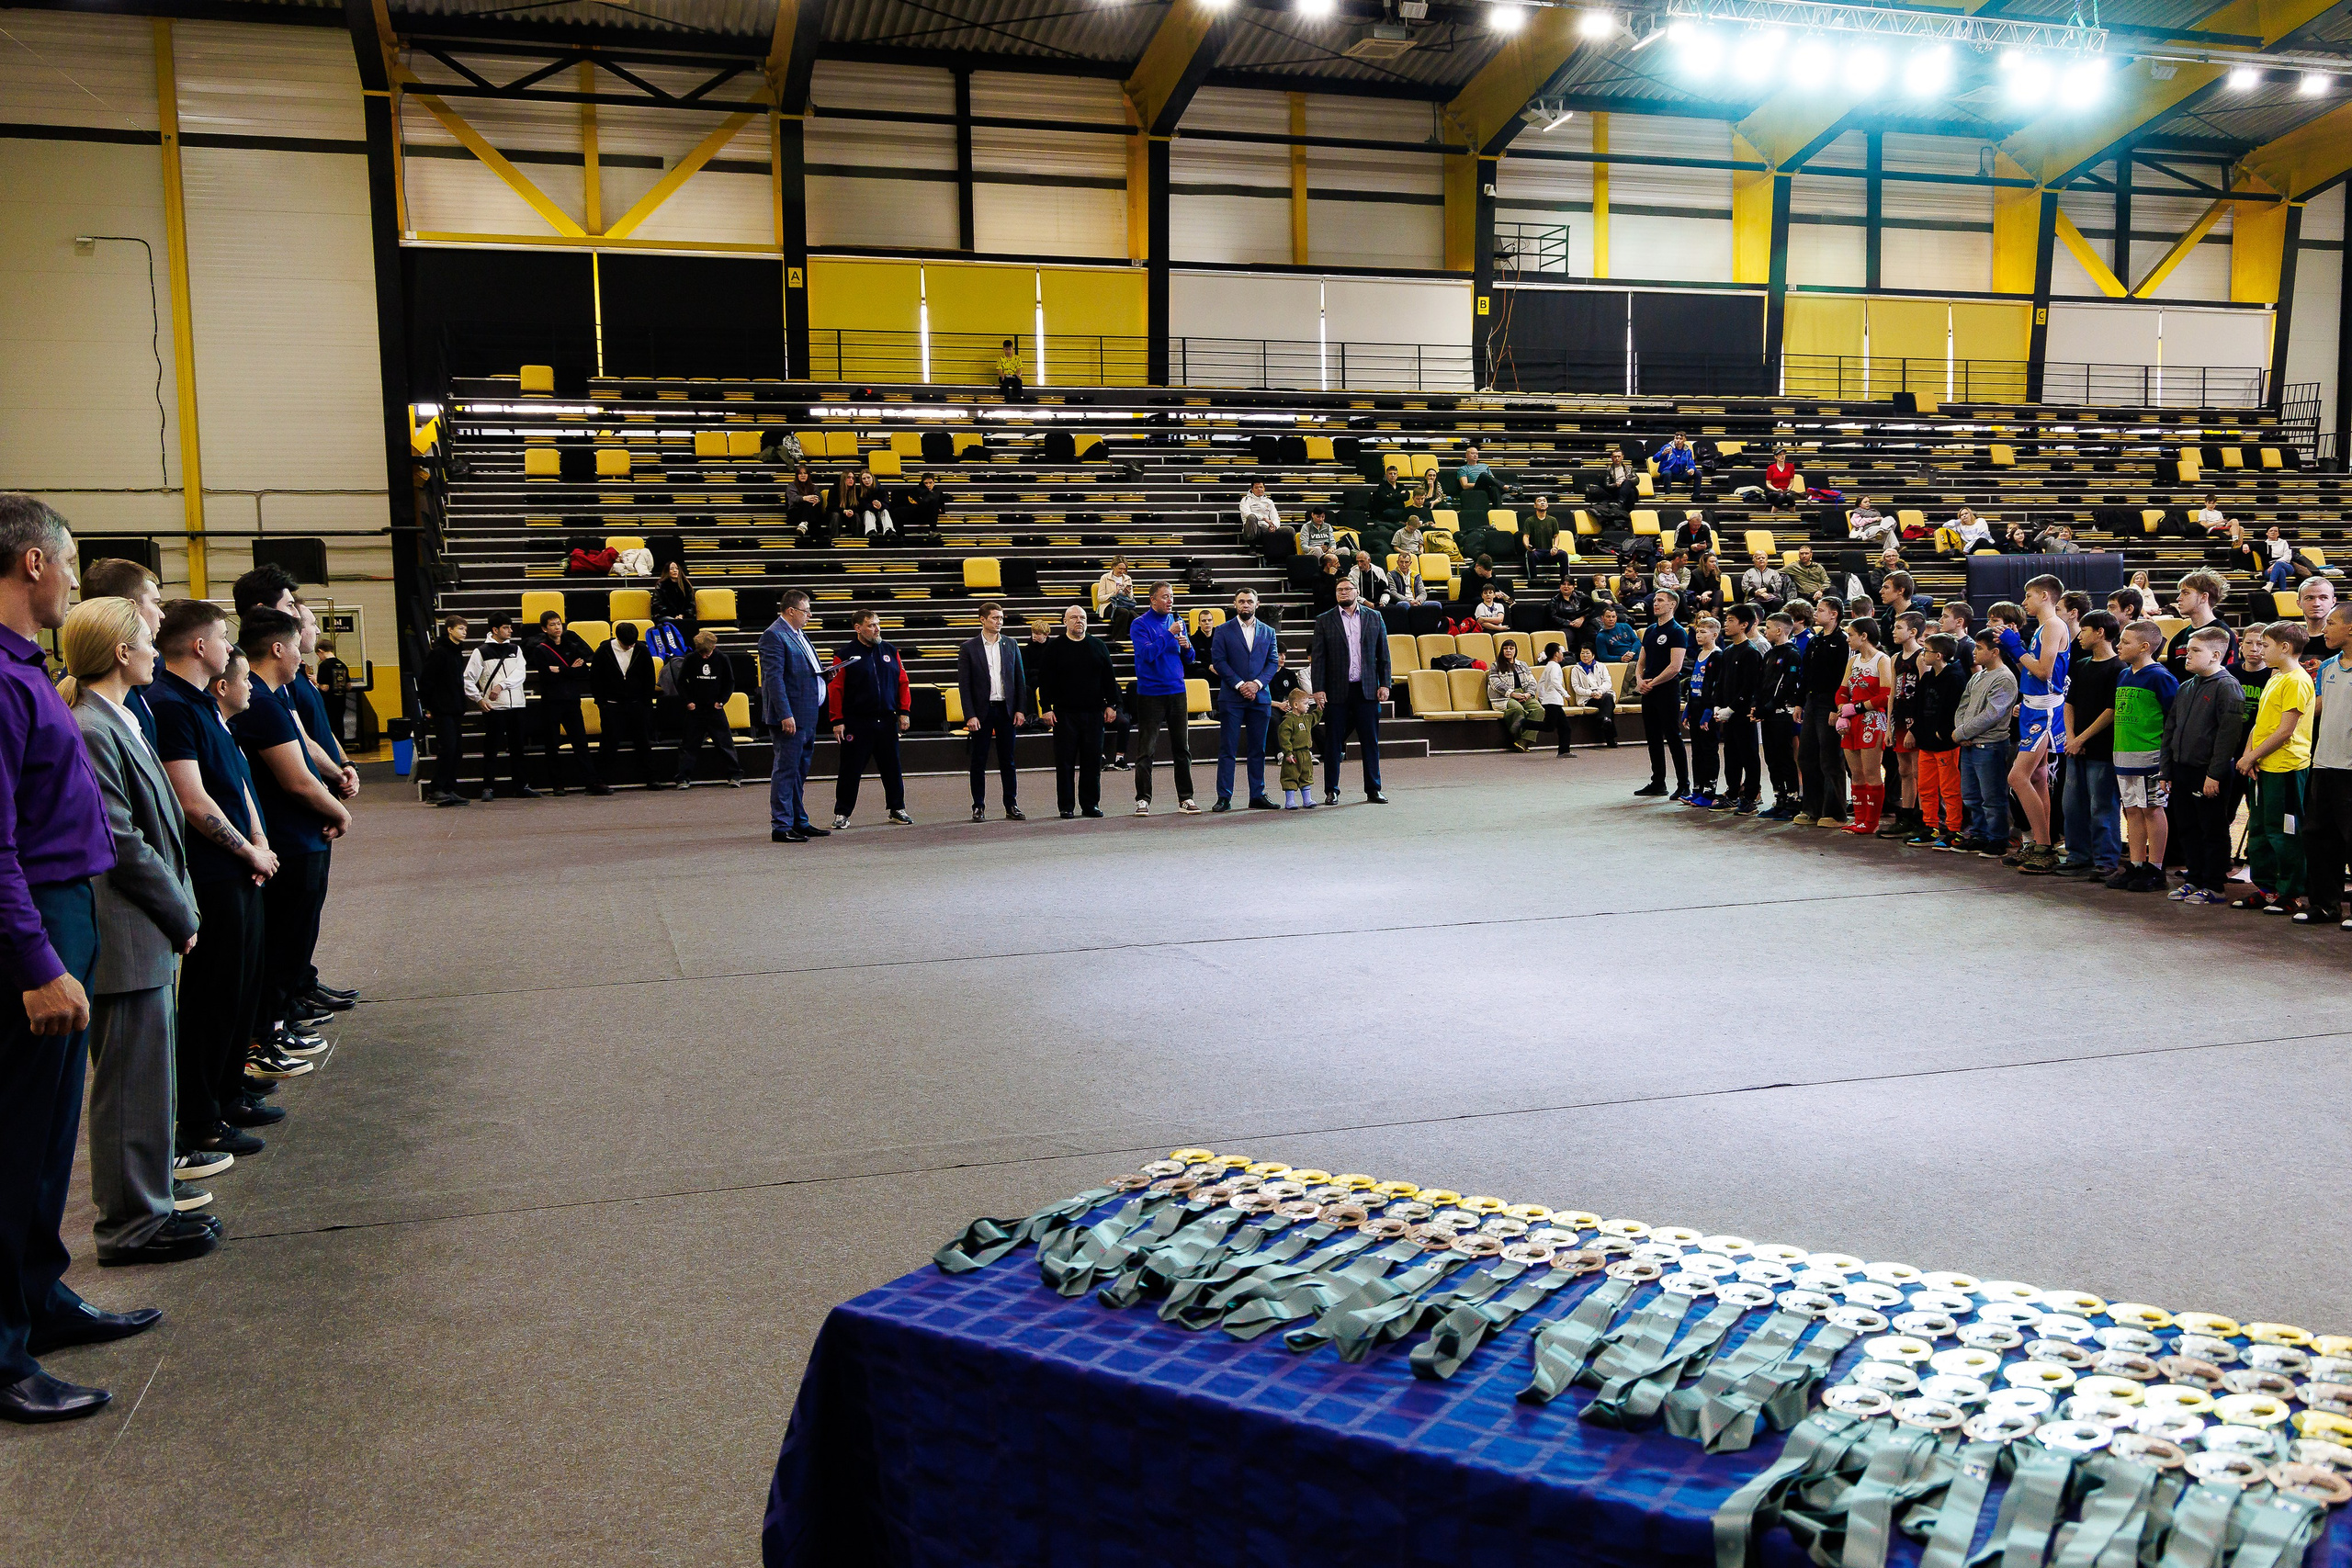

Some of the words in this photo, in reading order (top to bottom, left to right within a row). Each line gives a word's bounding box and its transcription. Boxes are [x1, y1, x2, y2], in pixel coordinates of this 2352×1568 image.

[790, 270, 800, 281] A
[1479, 299, 1487, 309] B
[2038, 310, 2045, 320] C
